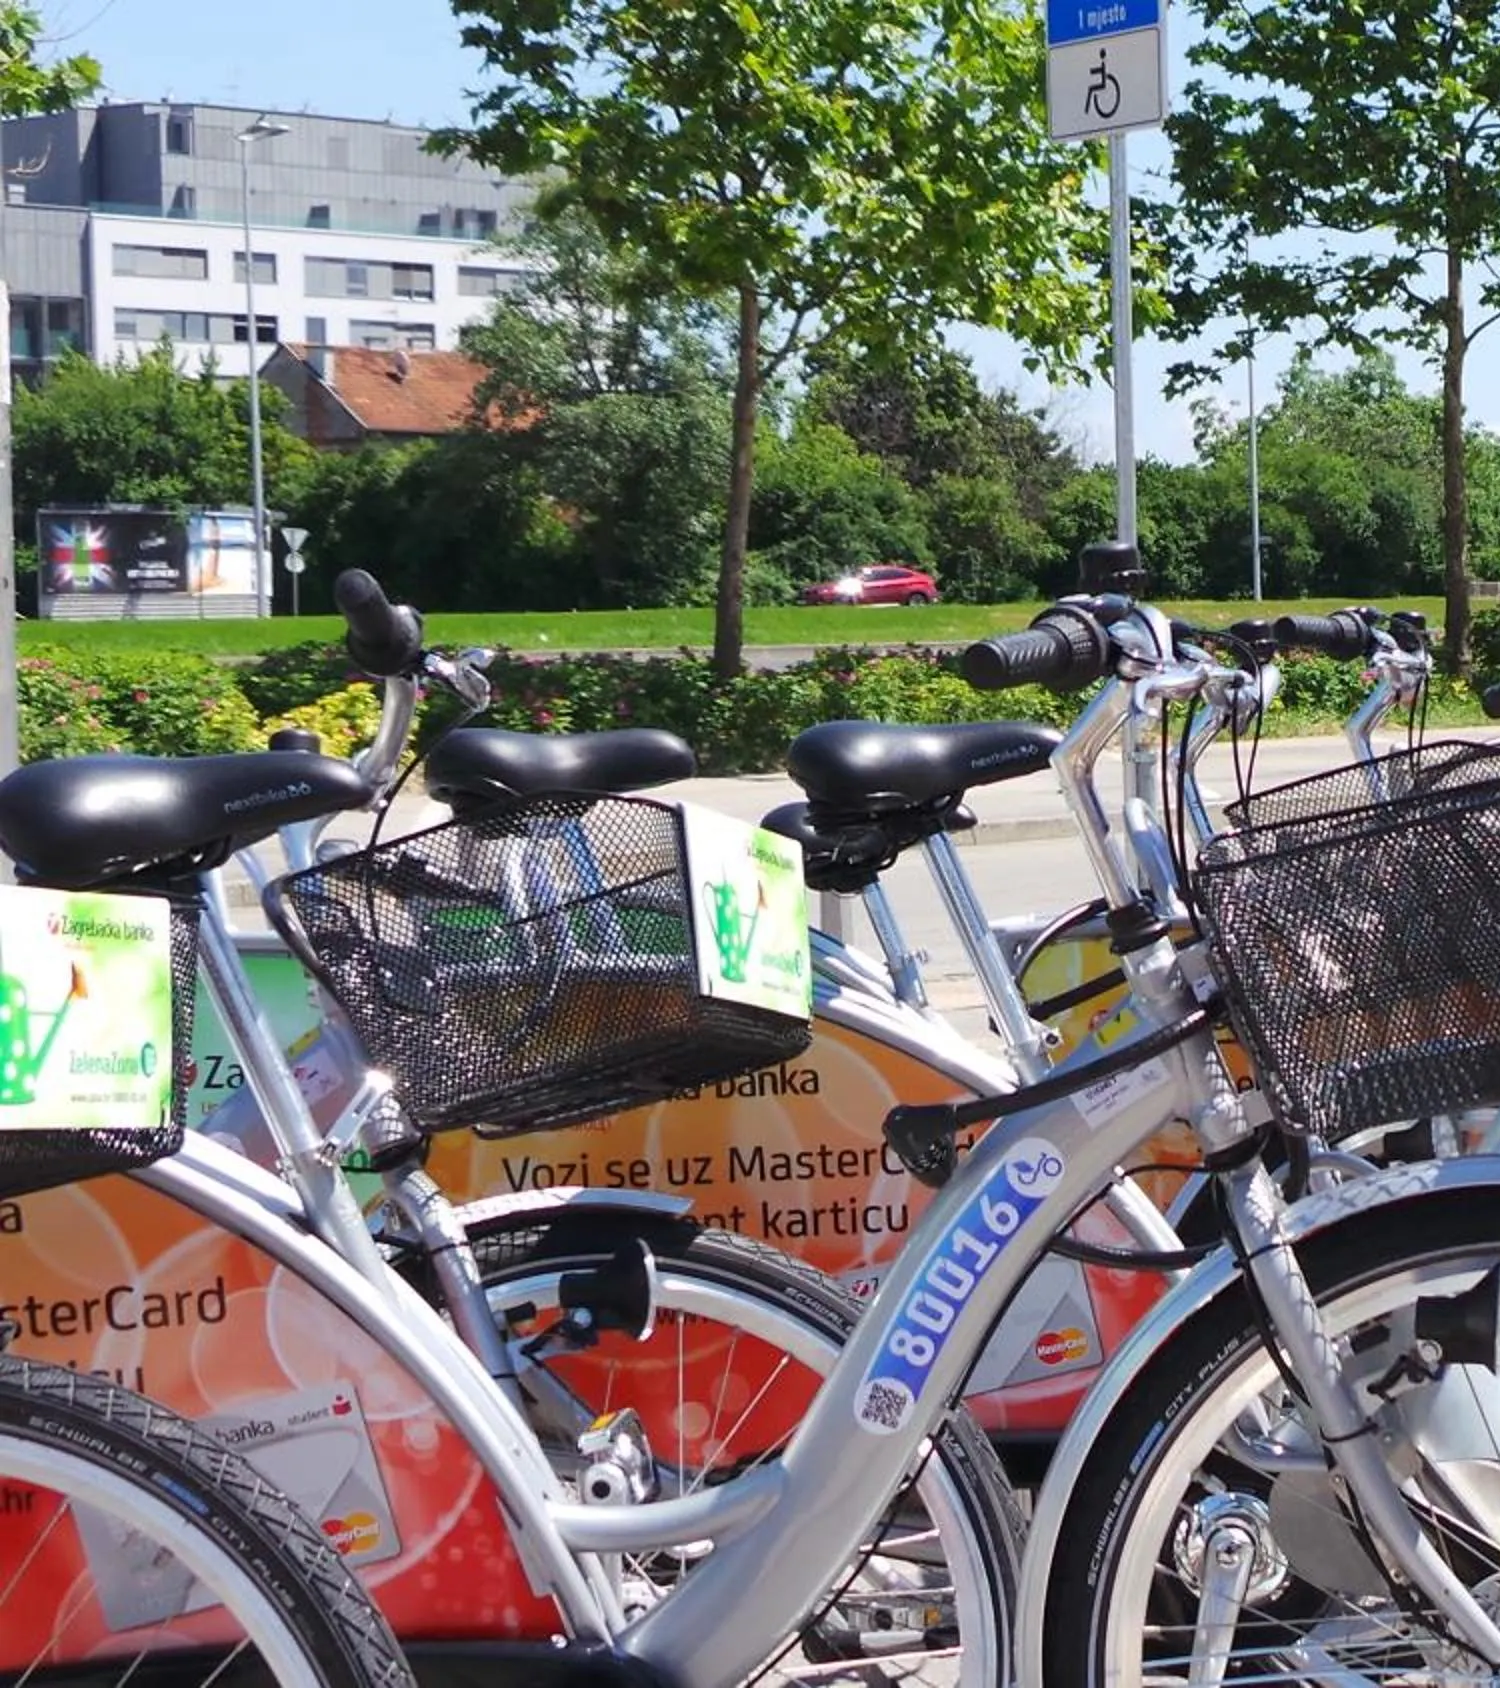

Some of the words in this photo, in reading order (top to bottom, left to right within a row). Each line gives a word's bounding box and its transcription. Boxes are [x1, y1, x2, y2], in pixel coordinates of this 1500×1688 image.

[1087, 4, 1126, 33] mjesto
[502, 1153, 590, 1191] Vozi
[604, 1154, 651, 1188] se
[667, 1156, 713, 1186] uz
[728, 1143, 906, 1183] MasterC
[762, 1198, 908, 1239] karticu
[0, 1275, 228, 1340] sterCard
[889, 1190, 1020, 1367] 80016
[1164, 1384, 1195, 1420] CITY
[1198, 1338, 1239, 1378] PLUS
[29, 1416, 148, 1473] SCHWALBE
[211, 1516, 250, 1551] CITY
[252, 1558, 296, 1608] PLUS
